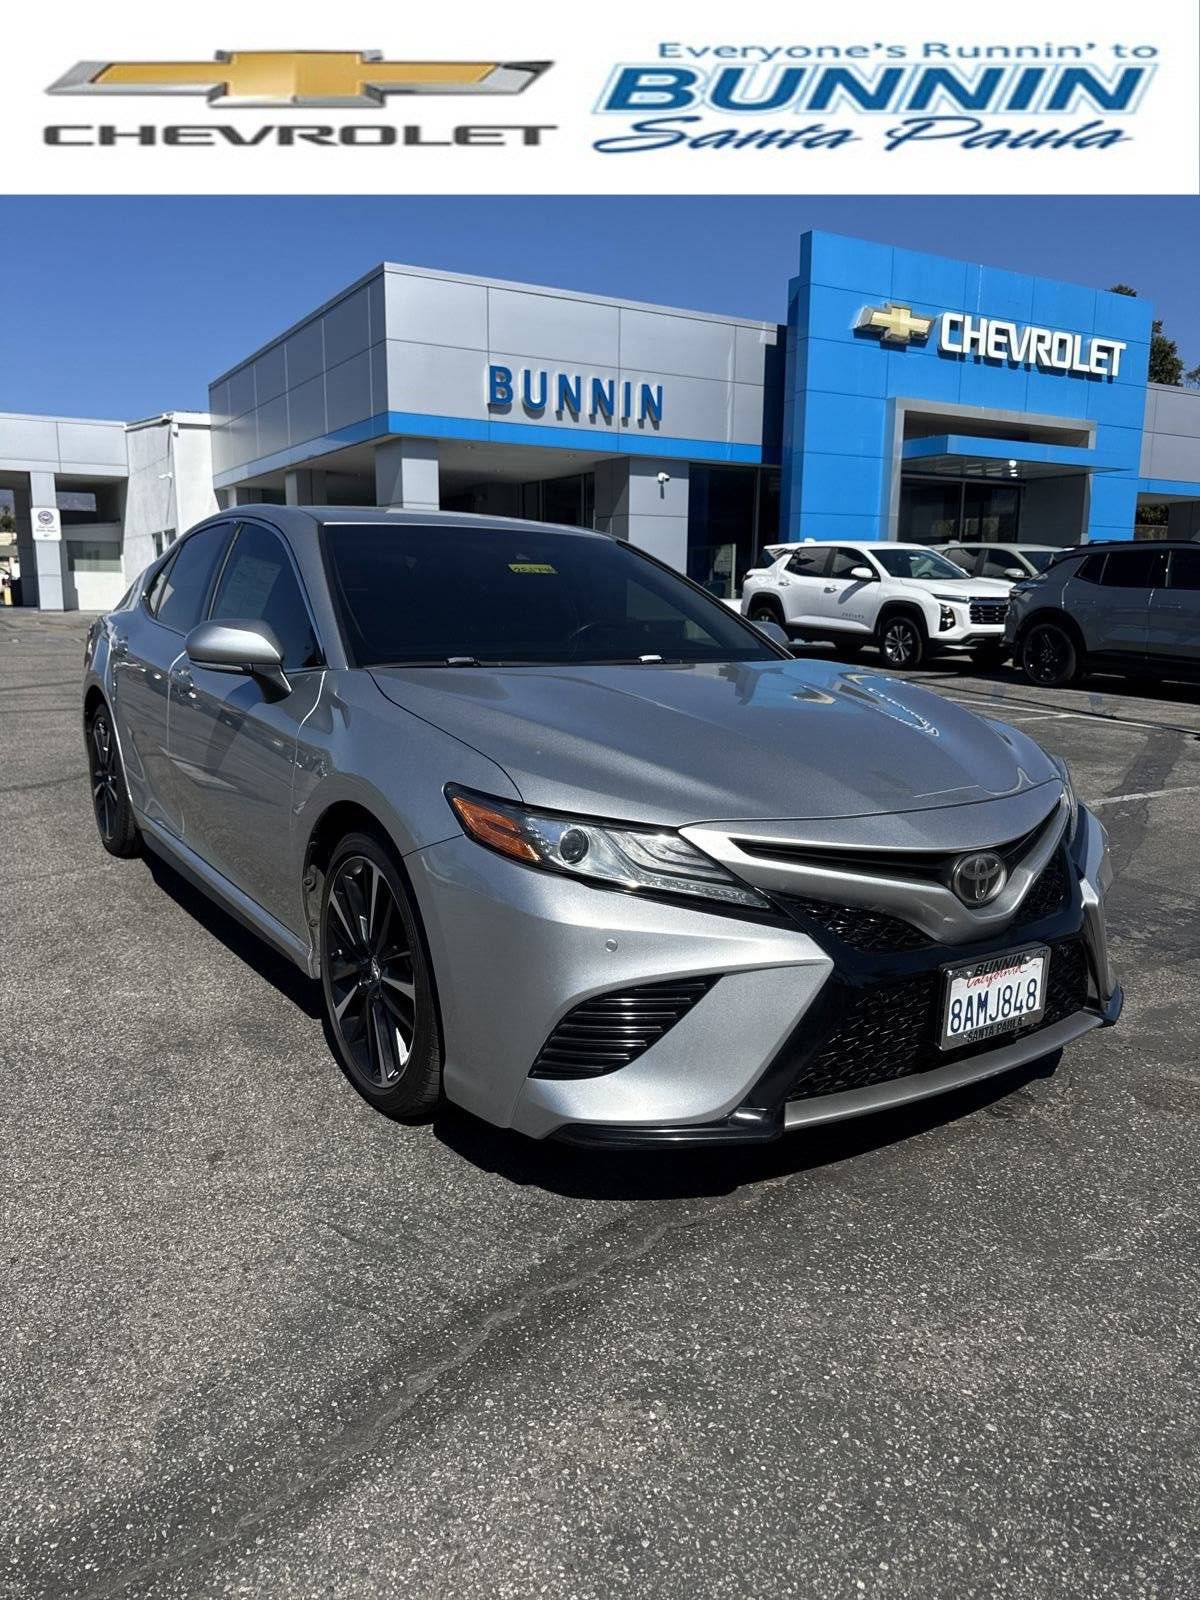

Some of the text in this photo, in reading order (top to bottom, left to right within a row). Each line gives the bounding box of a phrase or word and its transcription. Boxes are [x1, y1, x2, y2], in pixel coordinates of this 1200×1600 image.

[940, 311, 1127, 377] CHEVROLET
[488, 365, 663, 423] BUNNIN
[974, 953, 1025, 976] BUNNIN
[950, 978, 1037, 1033] 8AMJ848
[967, 1022, 994, 1042] SANTA
